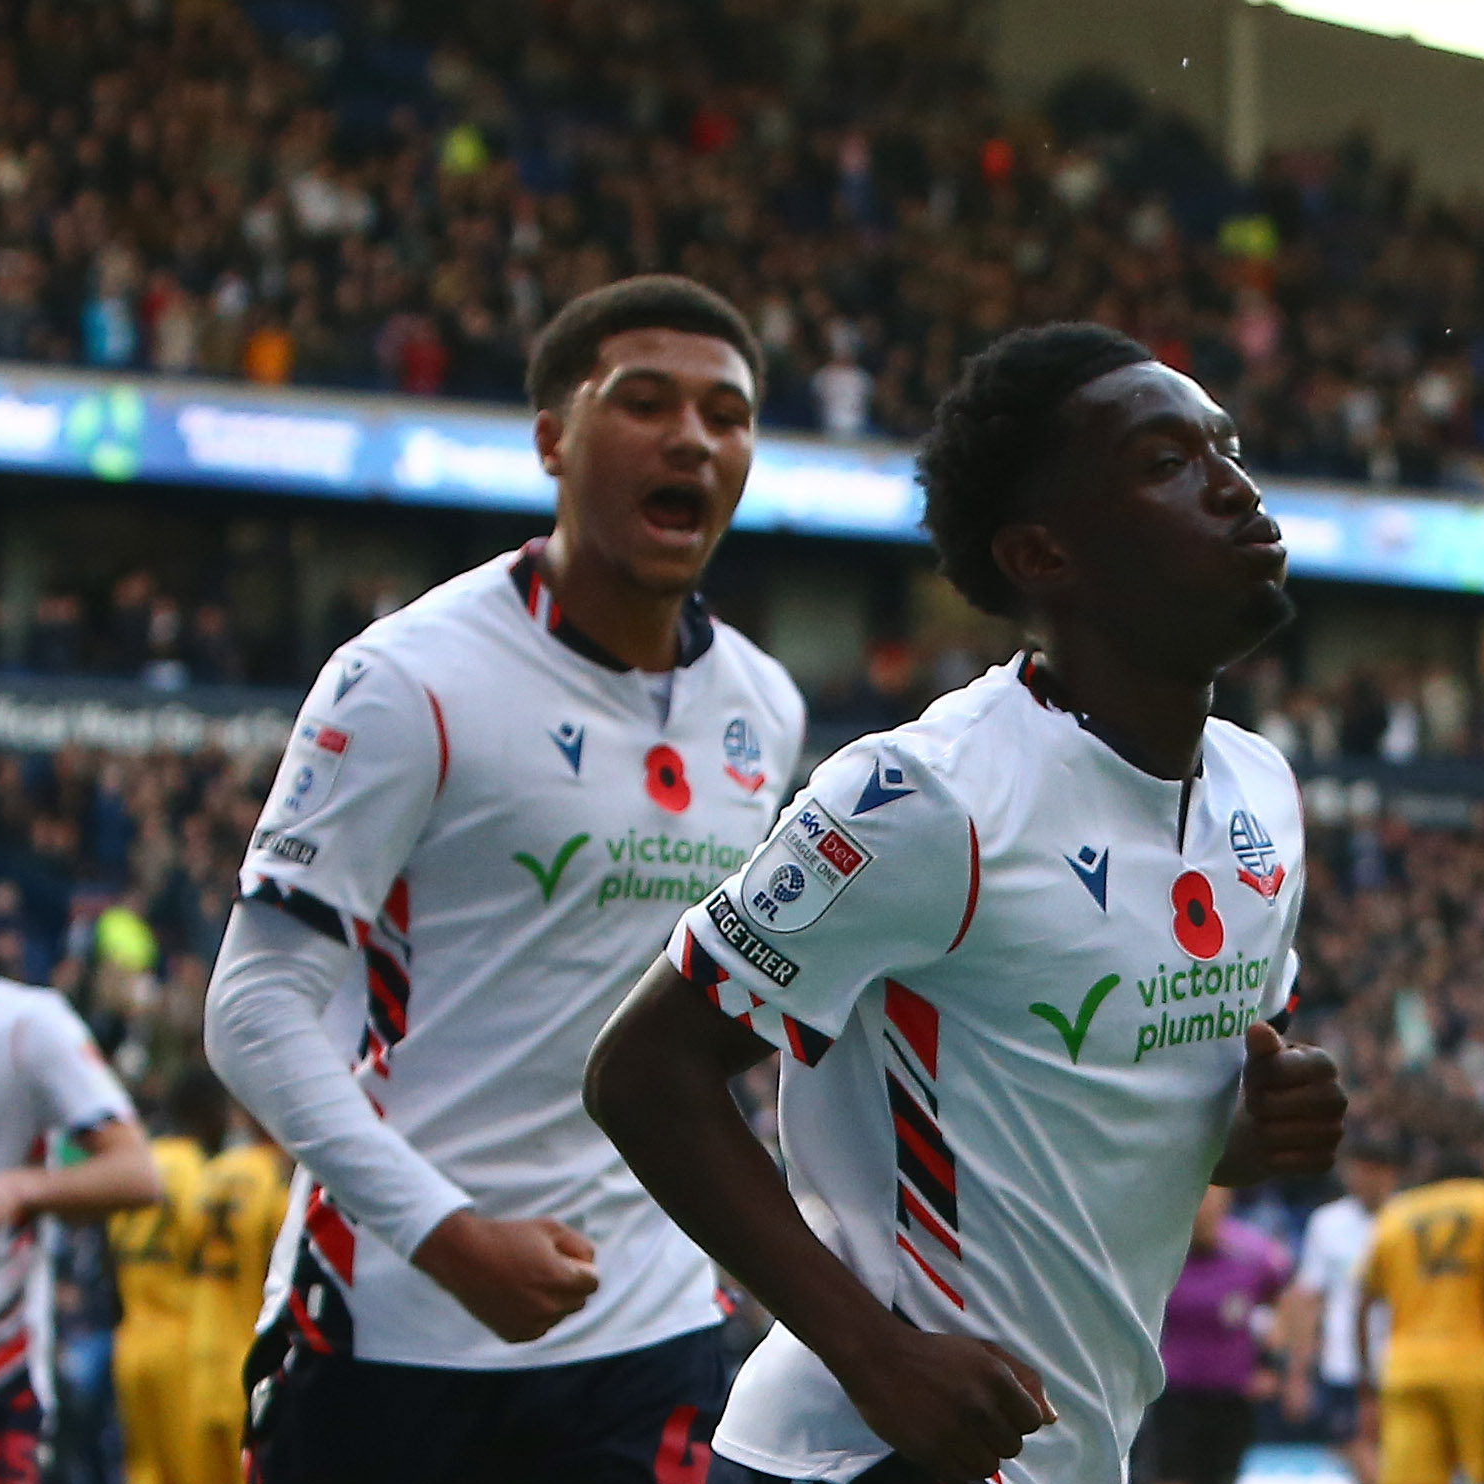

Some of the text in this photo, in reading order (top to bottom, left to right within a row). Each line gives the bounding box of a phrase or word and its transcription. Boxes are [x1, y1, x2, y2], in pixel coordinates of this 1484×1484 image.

[784, 829, 839, 888] LEAGUE ONE
[799, 811, 854, 869] sky bet
[752, 891, 780, 922] EFL
